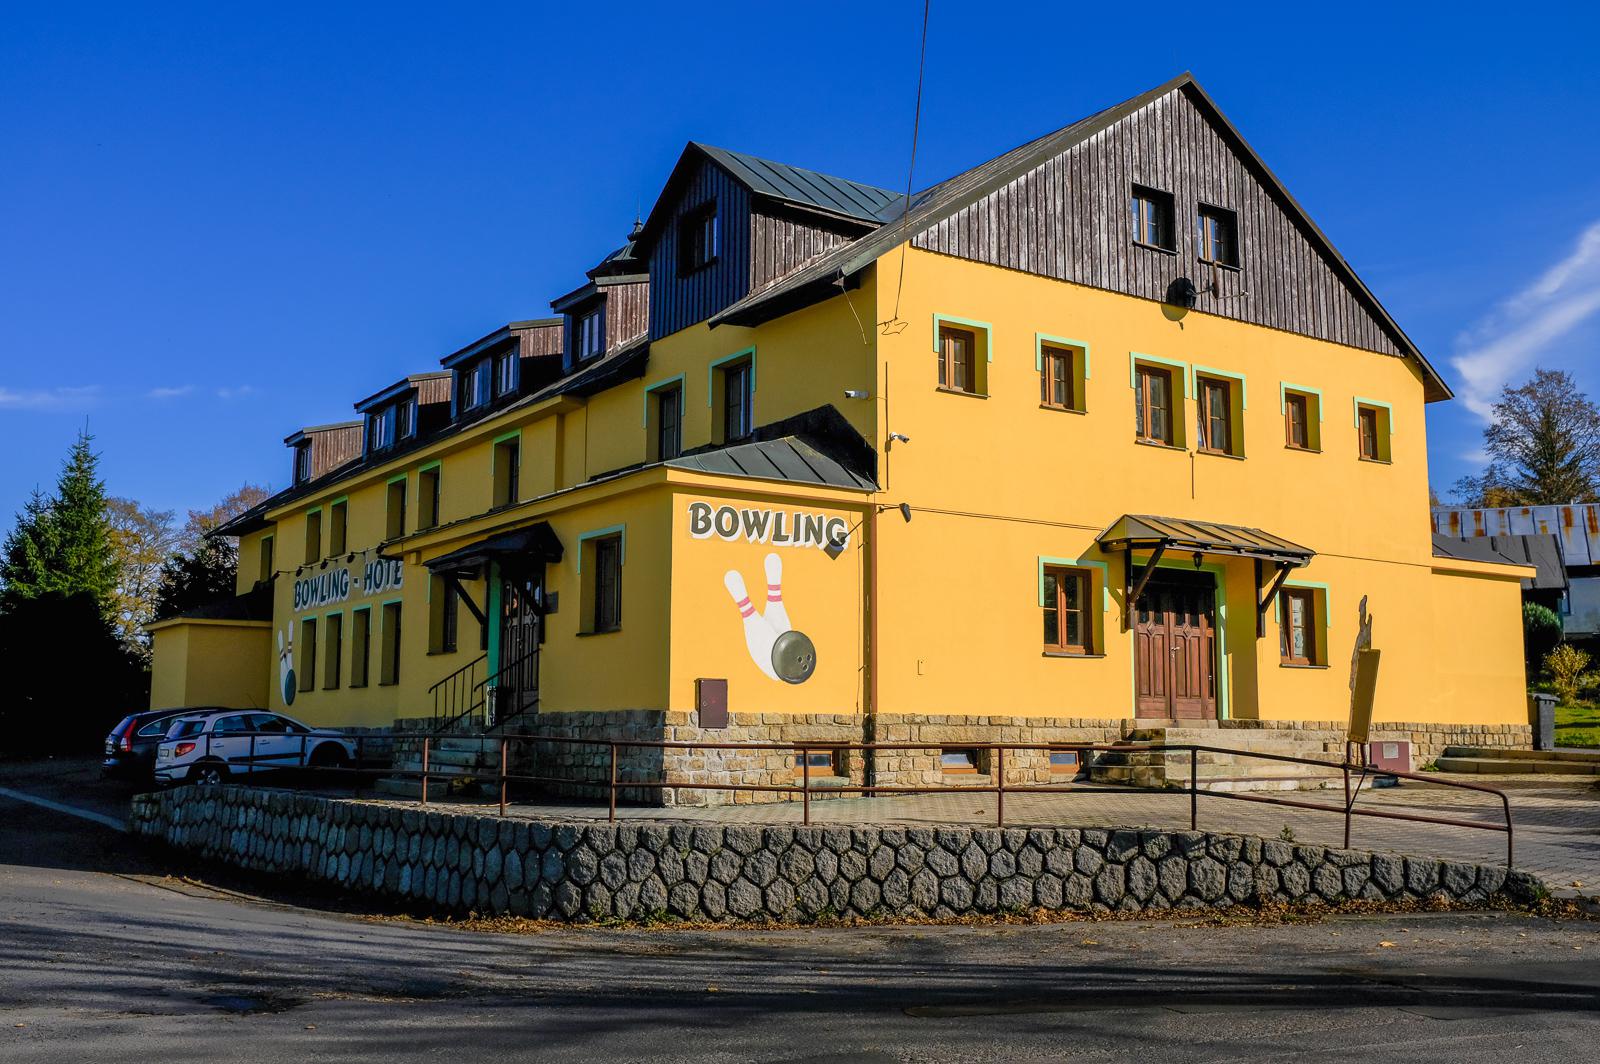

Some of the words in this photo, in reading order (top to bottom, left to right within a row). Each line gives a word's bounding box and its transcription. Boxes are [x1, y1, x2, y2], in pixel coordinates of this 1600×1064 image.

[689, 501, 848, 548] BOWLING
[294, 568, 350, 611] BOWLING
[364, 558, 403, 594] HOTE
